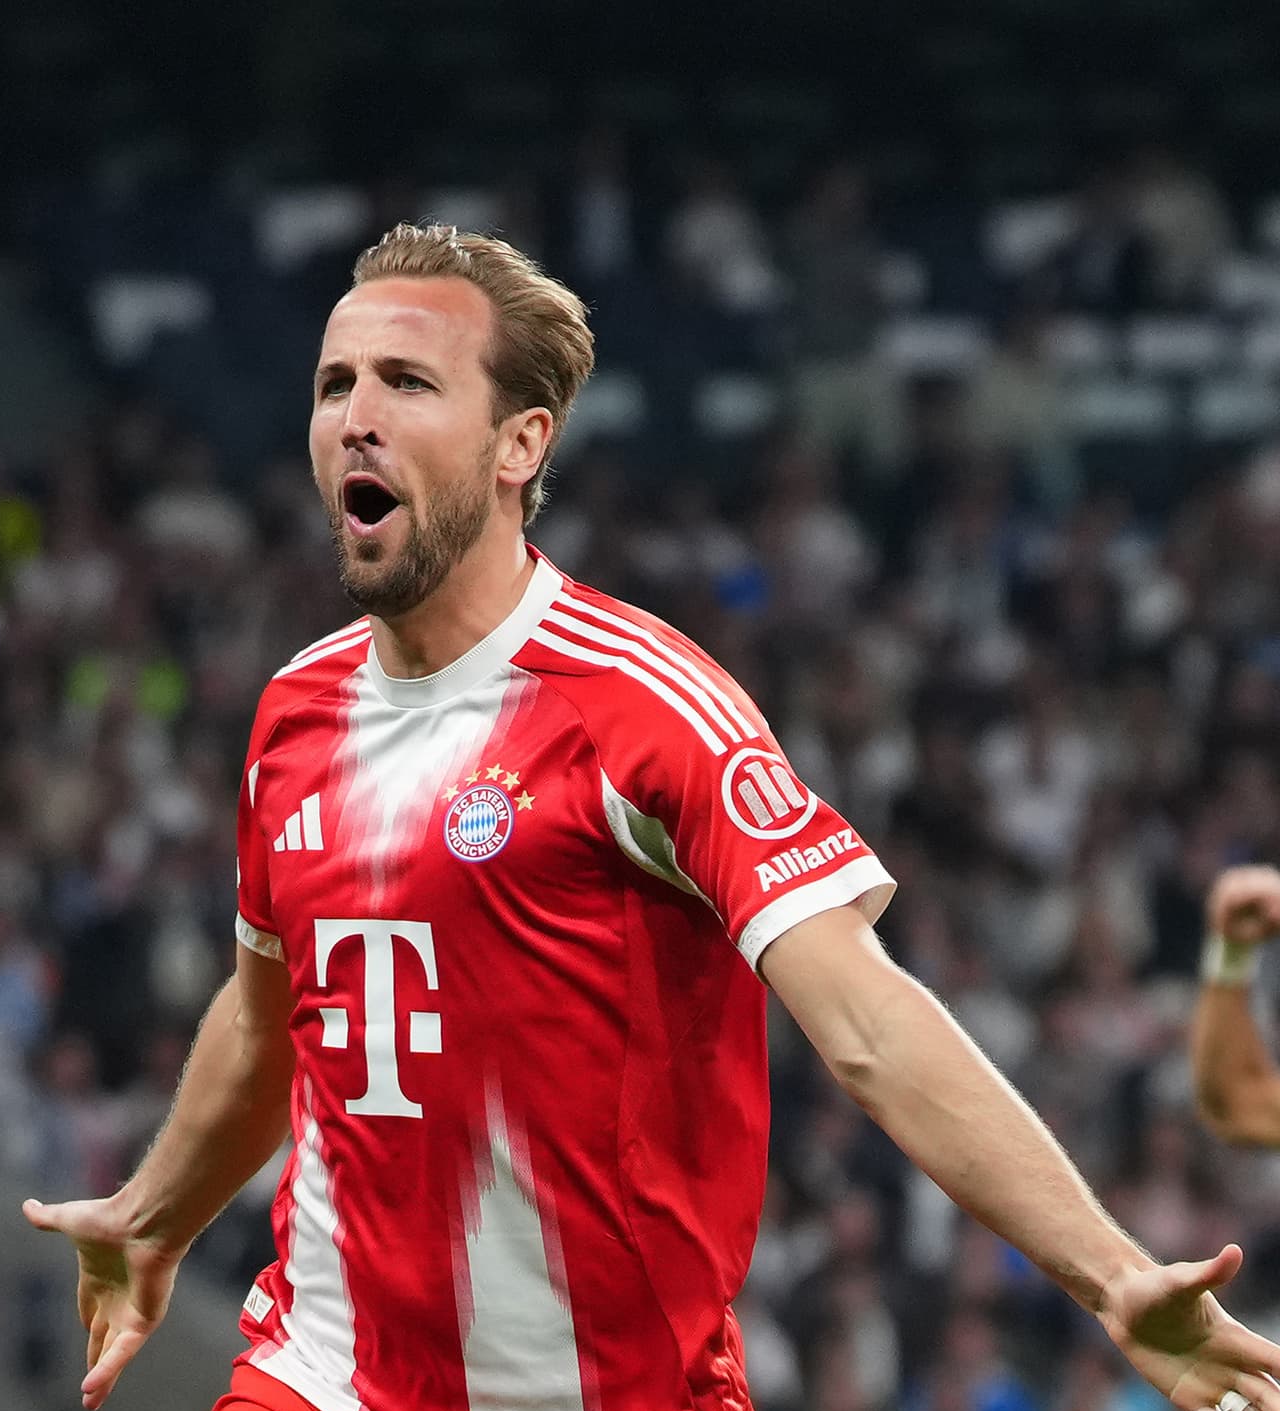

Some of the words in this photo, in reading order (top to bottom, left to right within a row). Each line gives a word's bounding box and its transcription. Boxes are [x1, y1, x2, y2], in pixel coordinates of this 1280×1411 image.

[454, 798, 470, 816] FC
[471, 791, 508, 821] BAYERN
[754, 828, 860, 893] Allianz
[314, 918, 442, 1119] T
